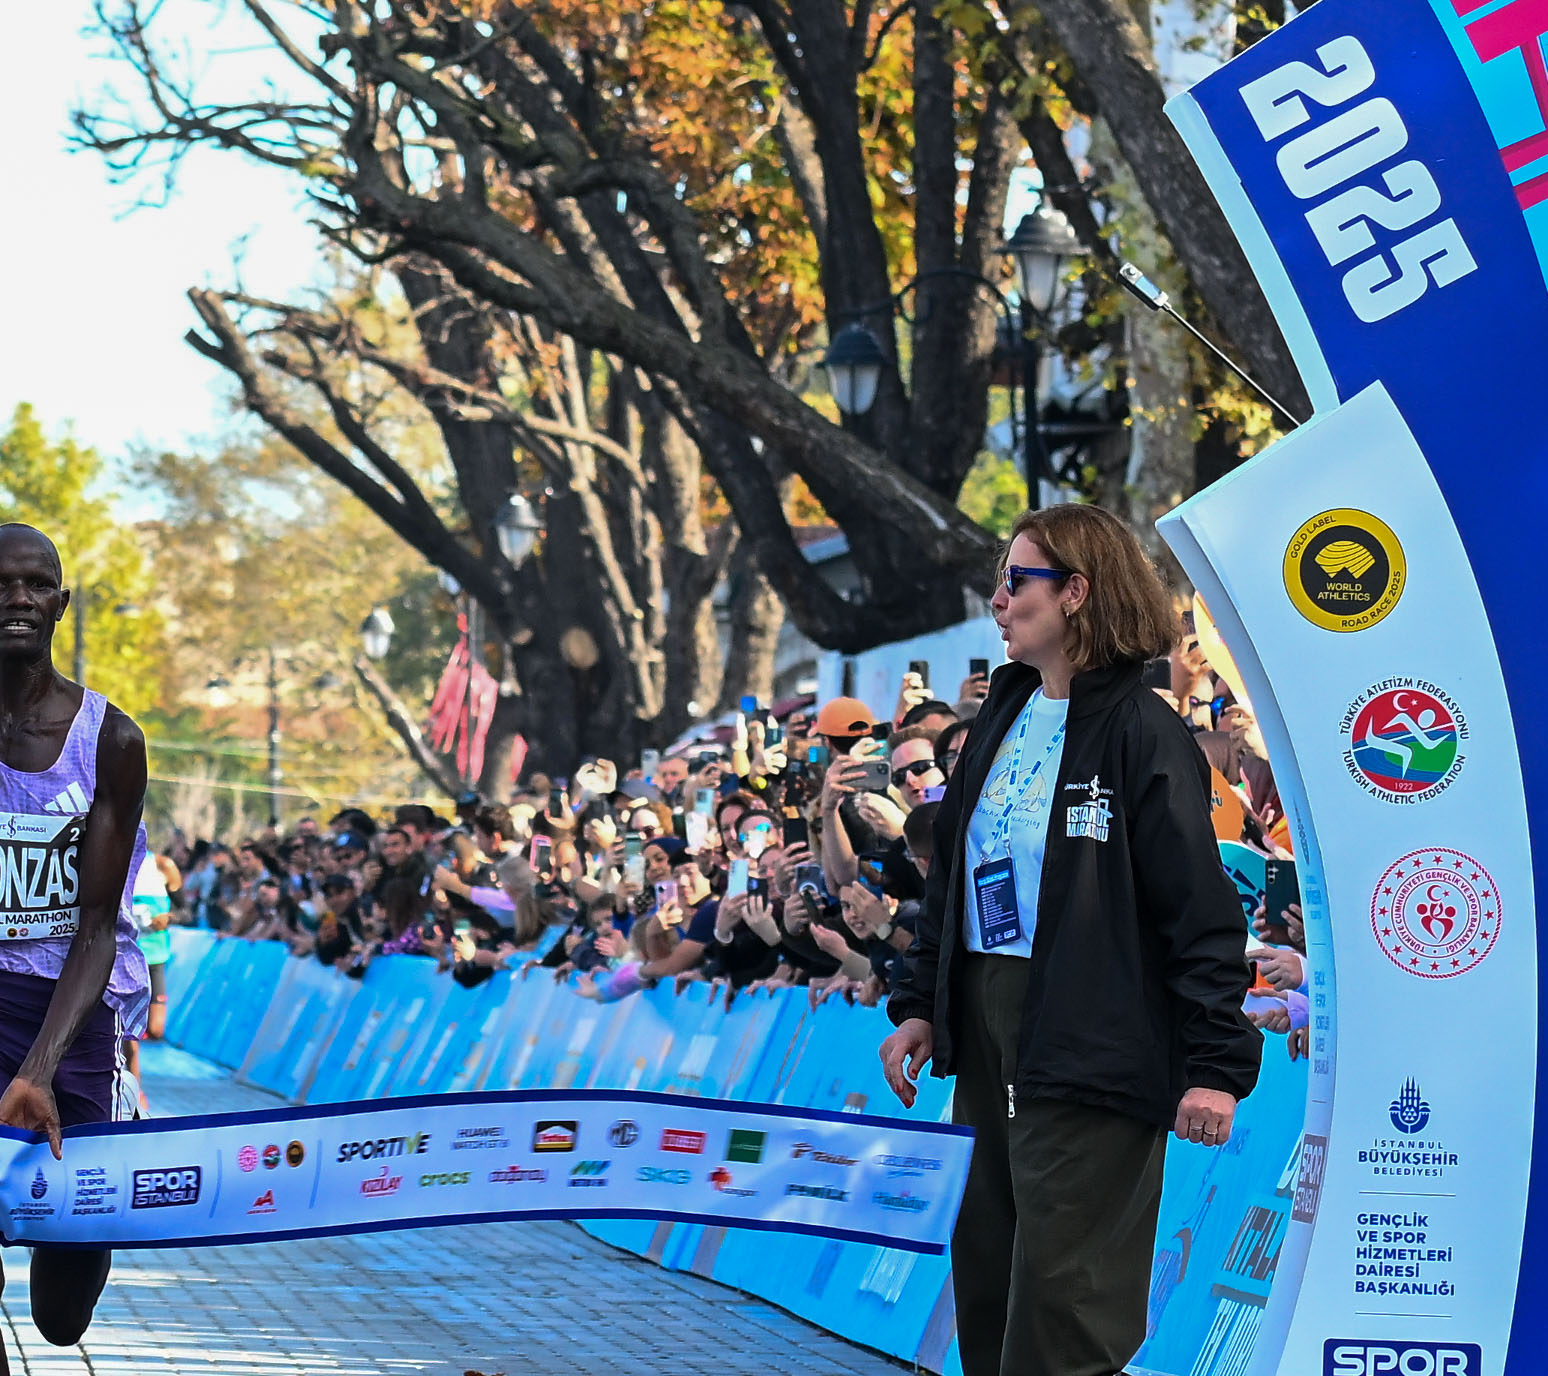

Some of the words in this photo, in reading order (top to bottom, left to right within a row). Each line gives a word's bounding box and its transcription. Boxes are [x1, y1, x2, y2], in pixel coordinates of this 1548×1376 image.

[1239, 35, 1478, 324] 2025
[1327, 583, 1362, 591] WORLD
[1318, 592, 1370, 601] ATHLETICS
[17, 825, 46, 833] BANKASI
[70, 828, 79, 842] 2
[6, 911, 71, 924] MARATHON
[50, 924, 74, 935] 2025
[337, 1131, 432, 1162] SPORTIVE
[1375, 1139, 1443, 1149] İSTANBUL
[1359, 1150, 1458, 1165] BÜYÜKŞEHİR
[1374, 1167, 1443, 1176] BELEDİYESİ
[136, 1170, 196, 1191] SPOR
[1358, 1212, 1428, 1228] GENÇLİK
[1358, 1231, 1377, 1242] VE
[1383, 1231, 1426, 1243] SPOR
[1356, 1246, 1451, 1261] HİZMETLERİ
[1356, 1262, 1419, 1277] DAİRESİ
[1355, 1281, 1454, 1296] BAŞKANLIĞI
